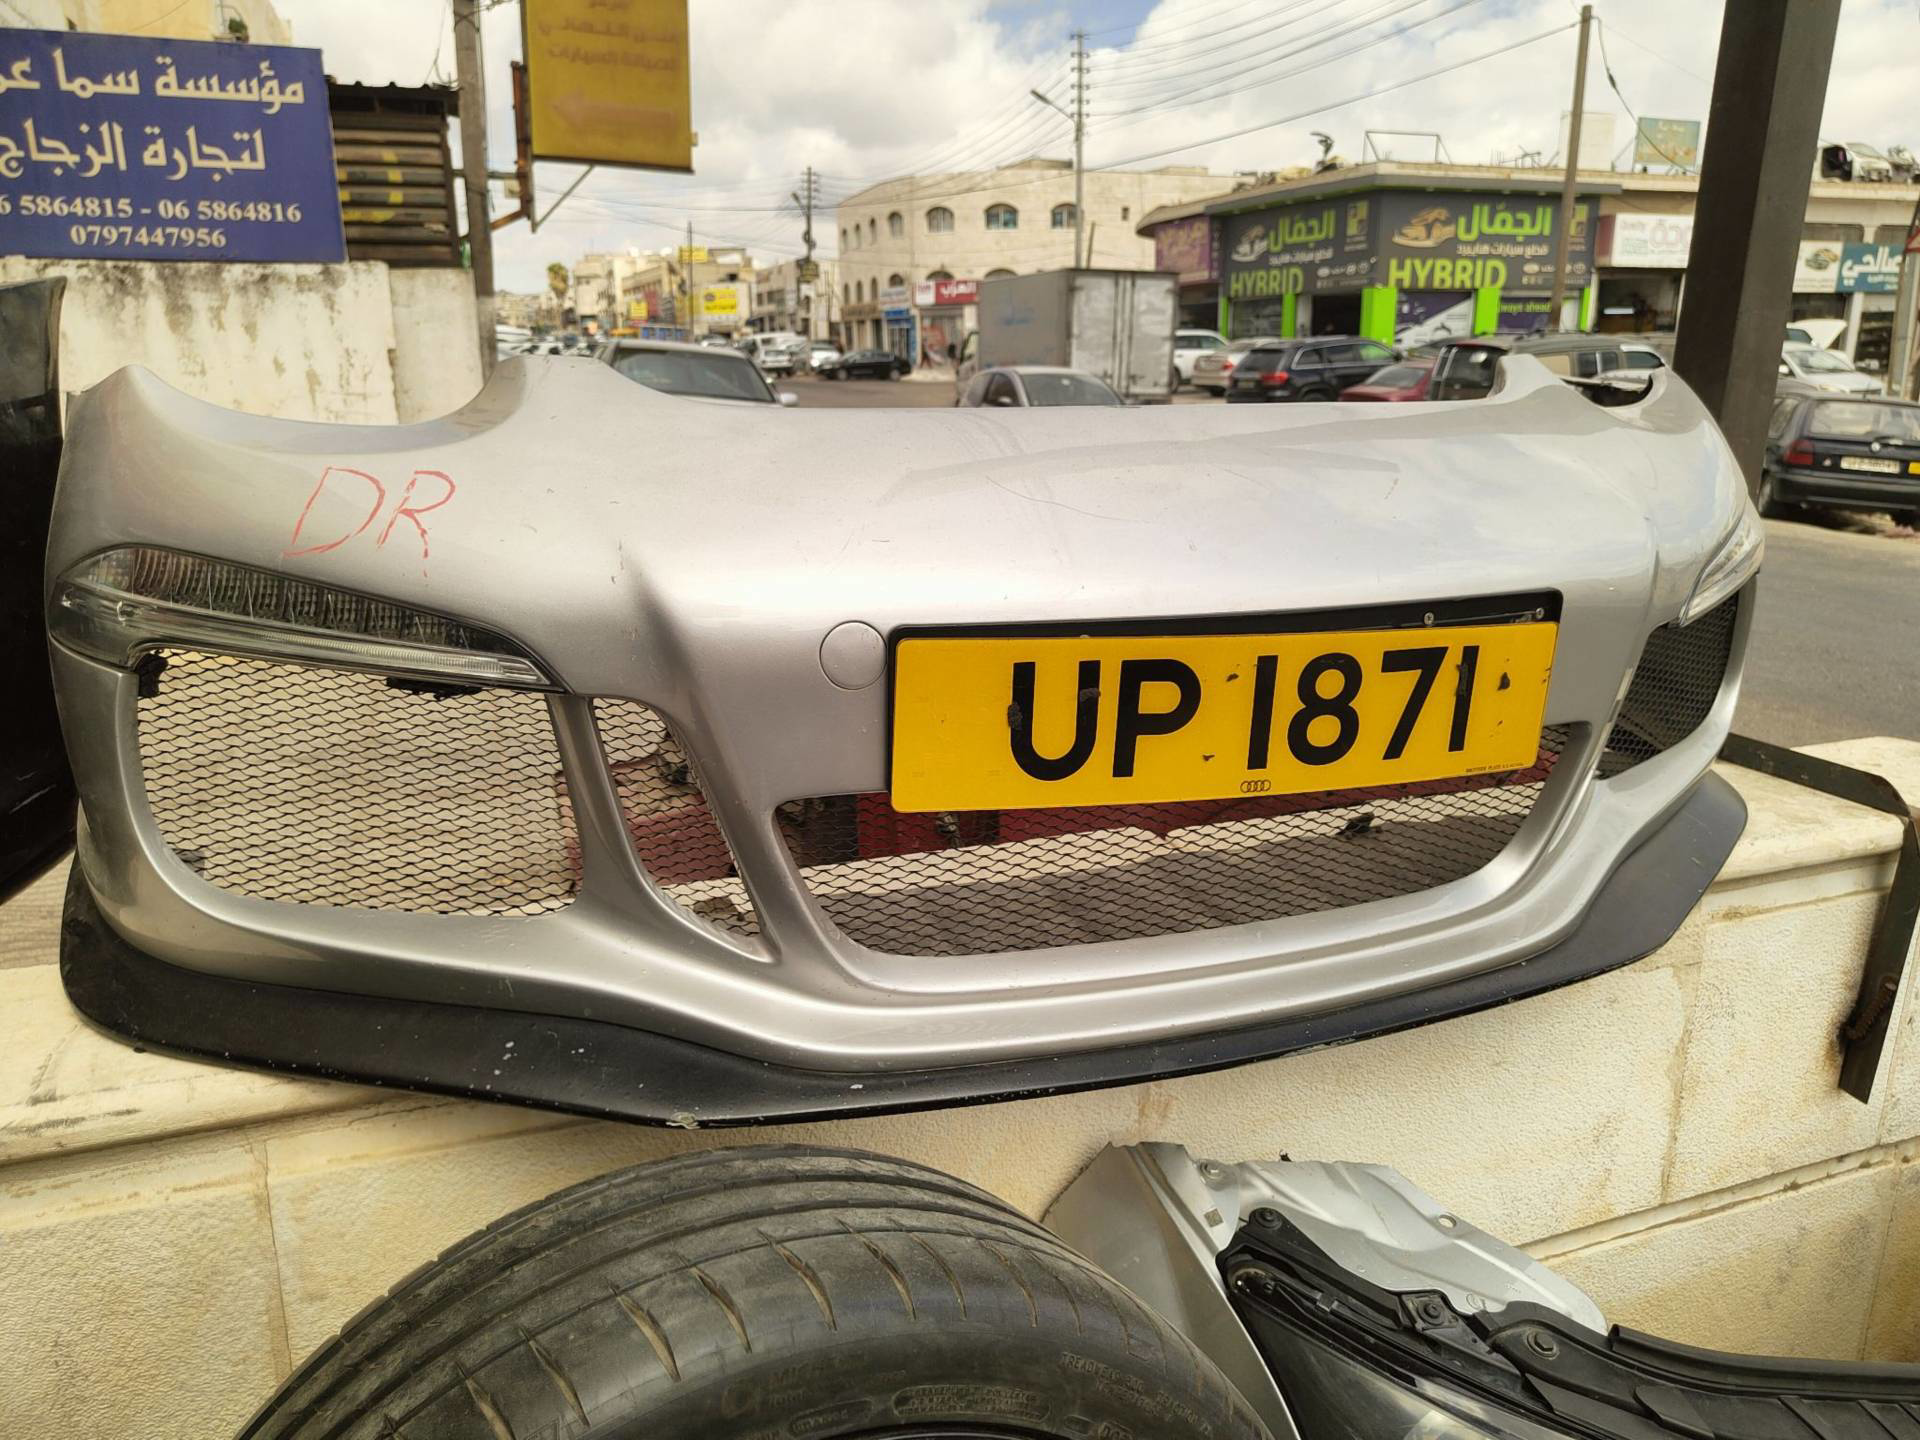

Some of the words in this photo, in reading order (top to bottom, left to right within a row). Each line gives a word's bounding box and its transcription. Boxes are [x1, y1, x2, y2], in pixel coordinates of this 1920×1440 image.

[53, 48, 140, 98] سما
[155, 56, 305, 114] مؤسسة
[0, 117, 127, 179] الزجاج
[143, 125, 266, 182] لتجارة
[19, 195, 133, 219] 5864815
[158, 199, 190, 220] 06
[197, 201, 302, 223] 5864816
[70, 224, 226, 248] 0797447956
[1230, 267, 1304, 297] HYBRID
[1387, 258, 1507, 290] HYBRID
[282, 466, 456, 560] DR
[1008, 658, 1202, 782] UP
[1246, 645, 1480, 771] 1871
